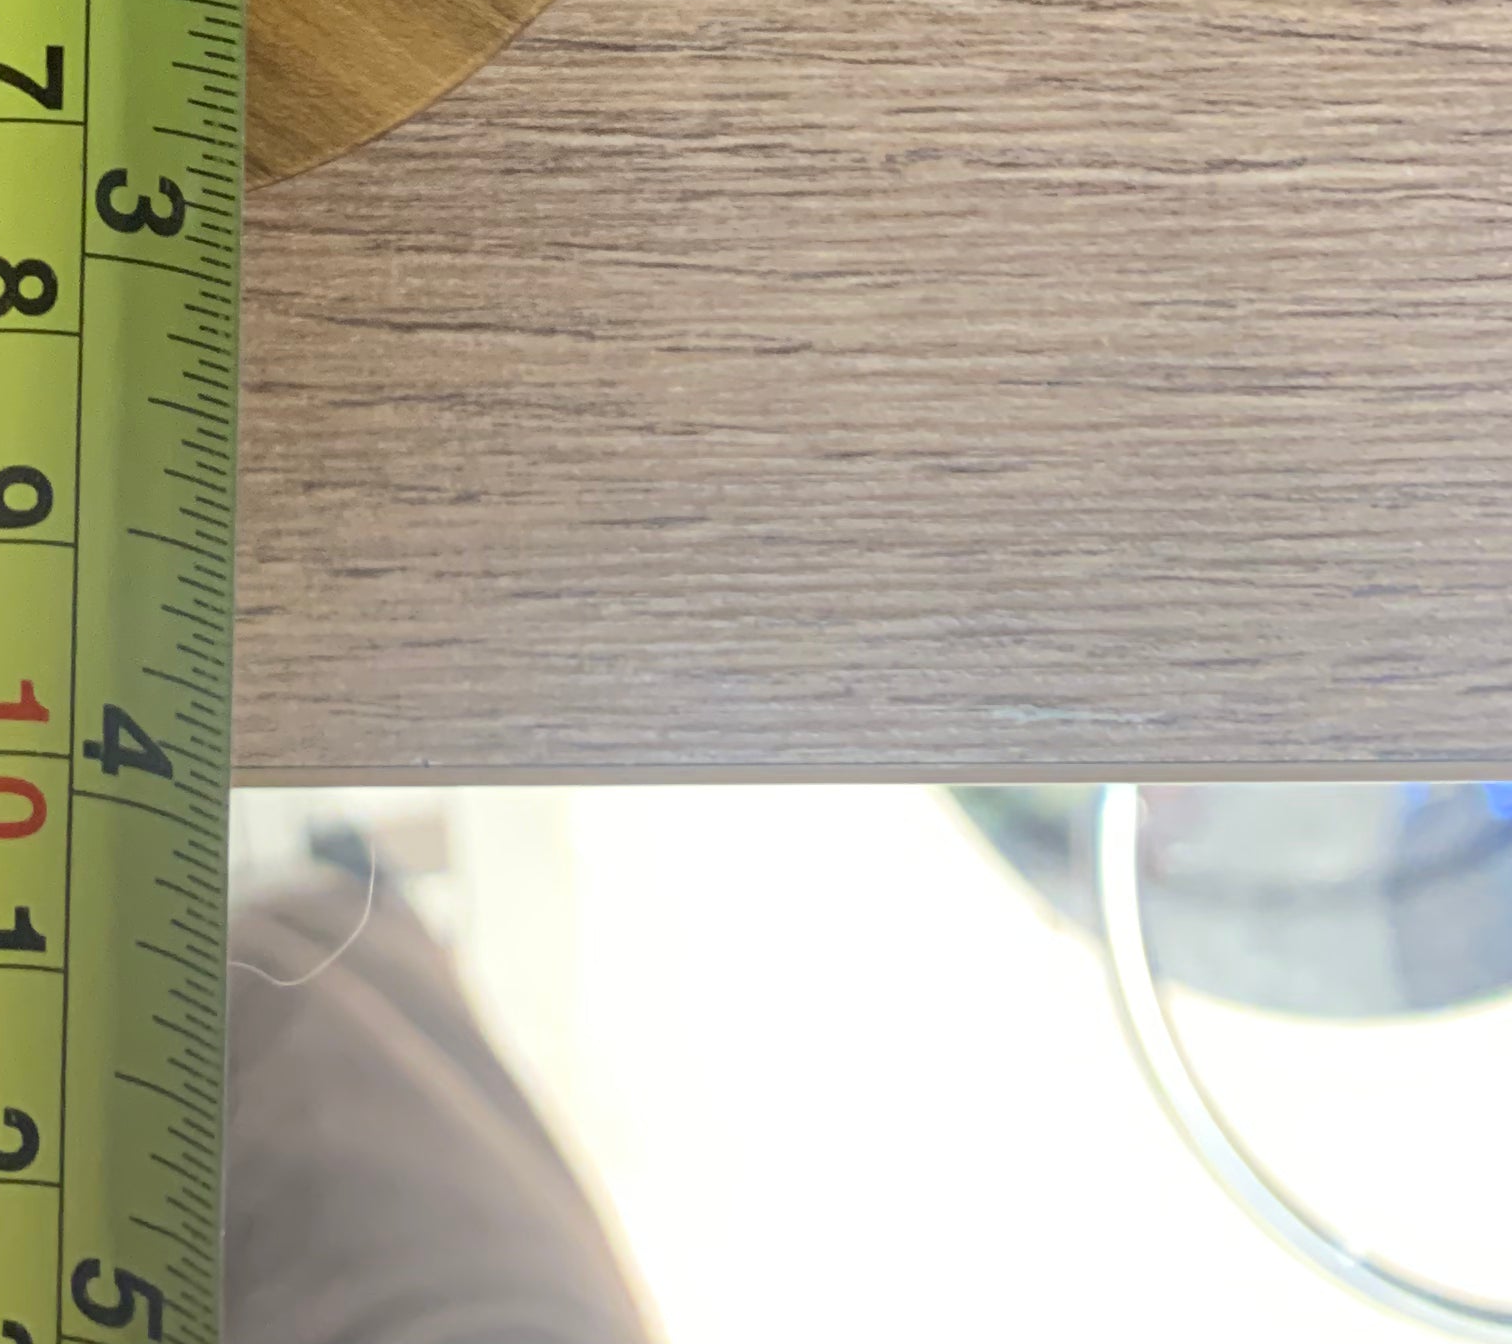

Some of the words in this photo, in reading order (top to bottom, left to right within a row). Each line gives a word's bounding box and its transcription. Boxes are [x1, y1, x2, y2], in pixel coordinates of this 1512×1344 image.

[95, 168, 186, 237] 3
[83, 703, 173, 780] 4
[71, 1258, 164, 1341] 5
